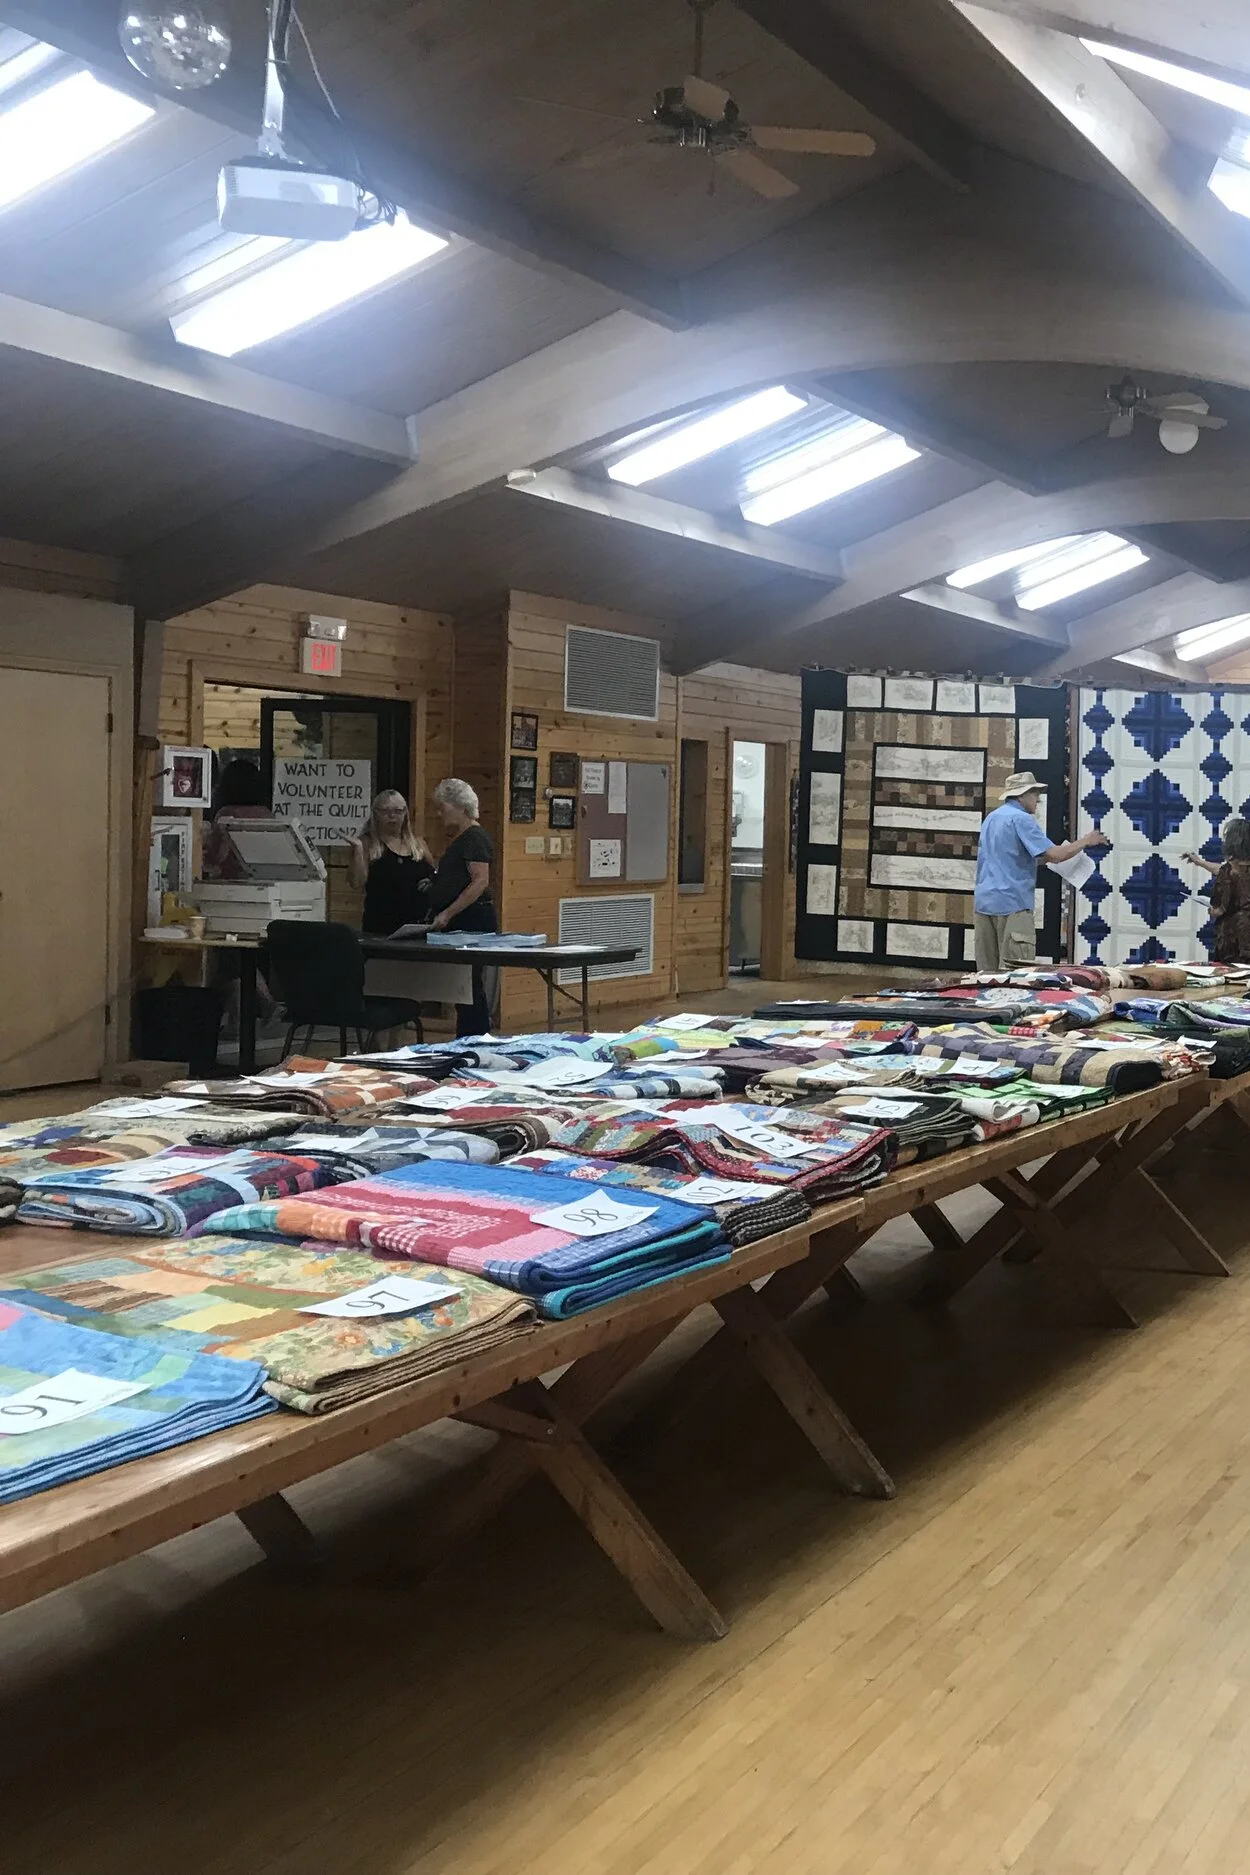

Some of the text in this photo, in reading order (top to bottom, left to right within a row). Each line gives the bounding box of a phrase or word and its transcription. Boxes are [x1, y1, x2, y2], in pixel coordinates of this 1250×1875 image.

[312, 642, 336, 671] EXIT
[284, 763, 355, 778] WANT TO
[277, 782, 363, 799] VOLUNTEER
[273, 802, 369, 818] AT THE QUILT
[734, 1126, 794, 1151] 103
[563, 1208, 618, 1227] 98
[345, 1290, 410, 1310] 97
[0, 1394, 87, 1420] 91
